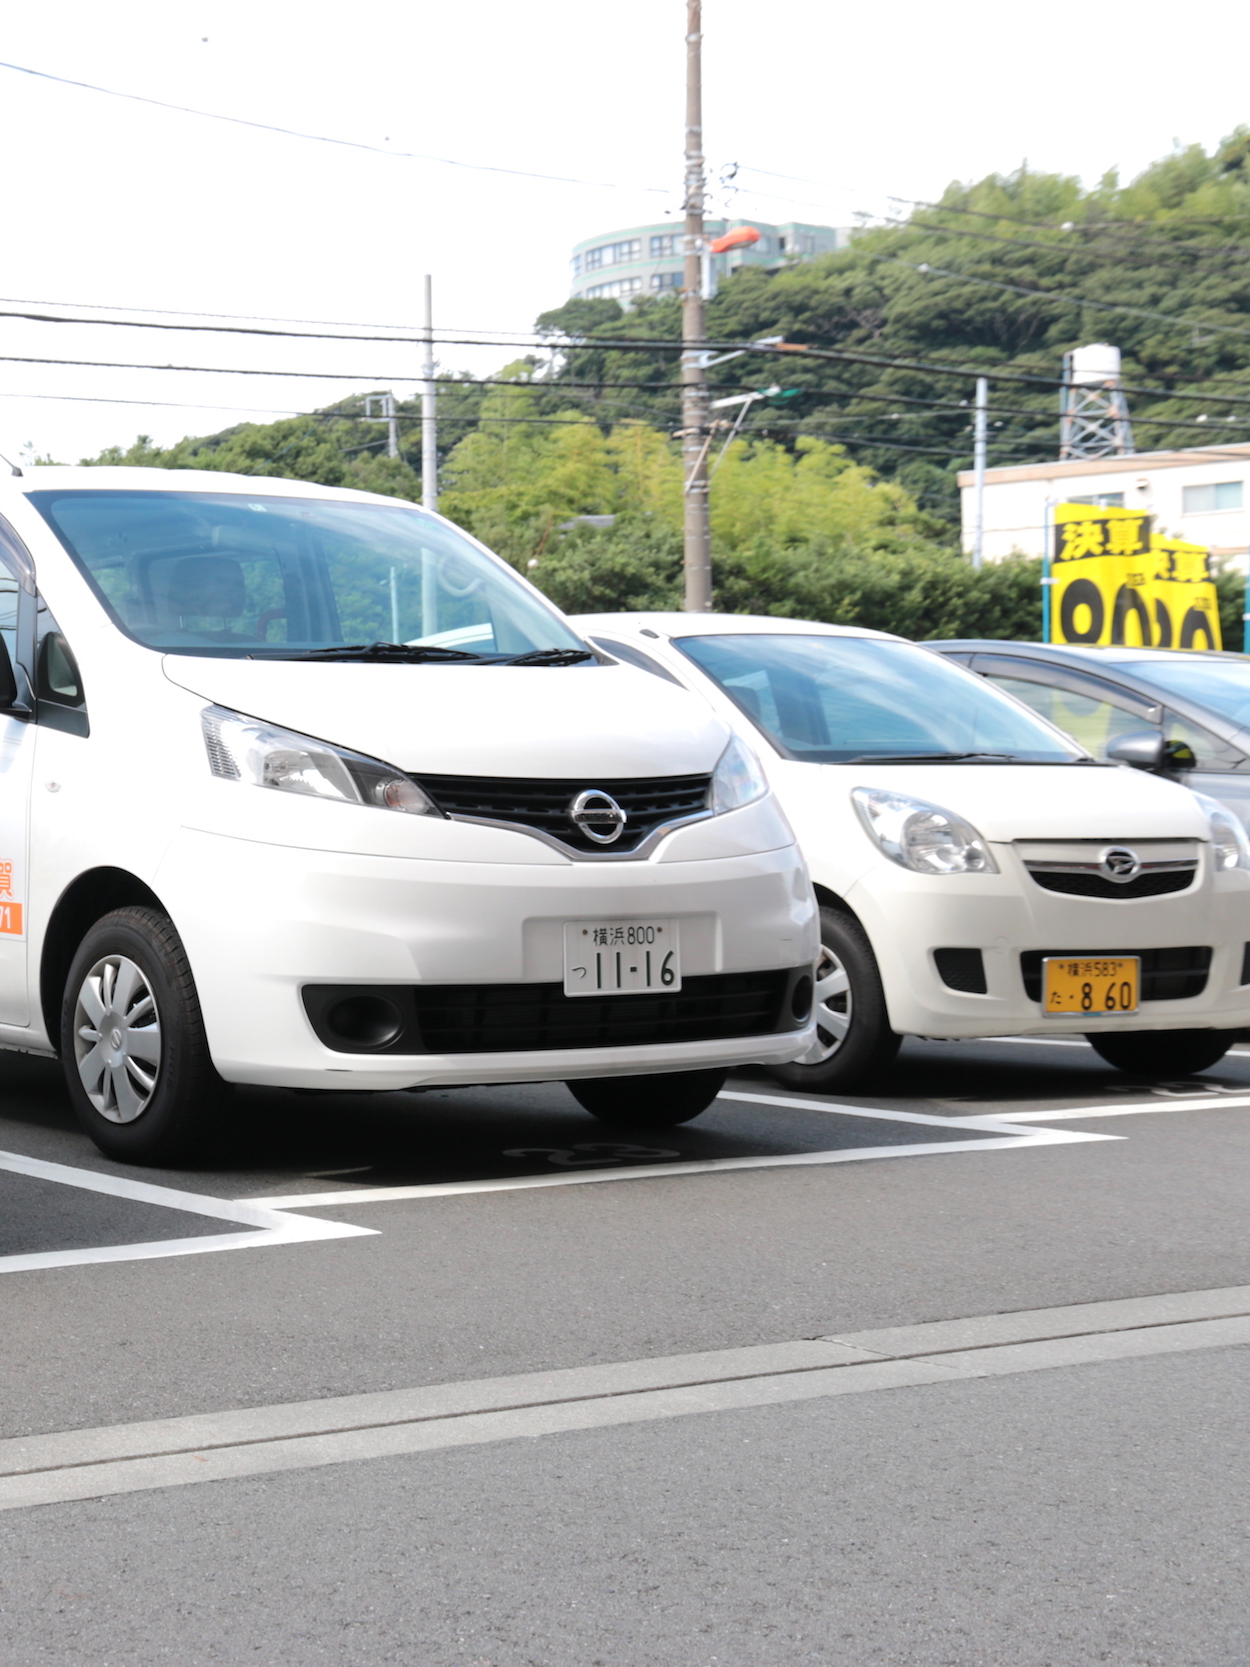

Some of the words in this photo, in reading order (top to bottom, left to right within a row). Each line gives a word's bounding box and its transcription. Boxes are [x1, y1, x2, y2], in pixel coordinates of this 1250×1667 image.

[1060, 519, 1144, 561] 決算
[593, 925, 655, 946] 横浜800
[572, 965, 587, 979] つ
[596, 949, 675, 989] 11-16
[1050, 991, 1062, 1004] た
